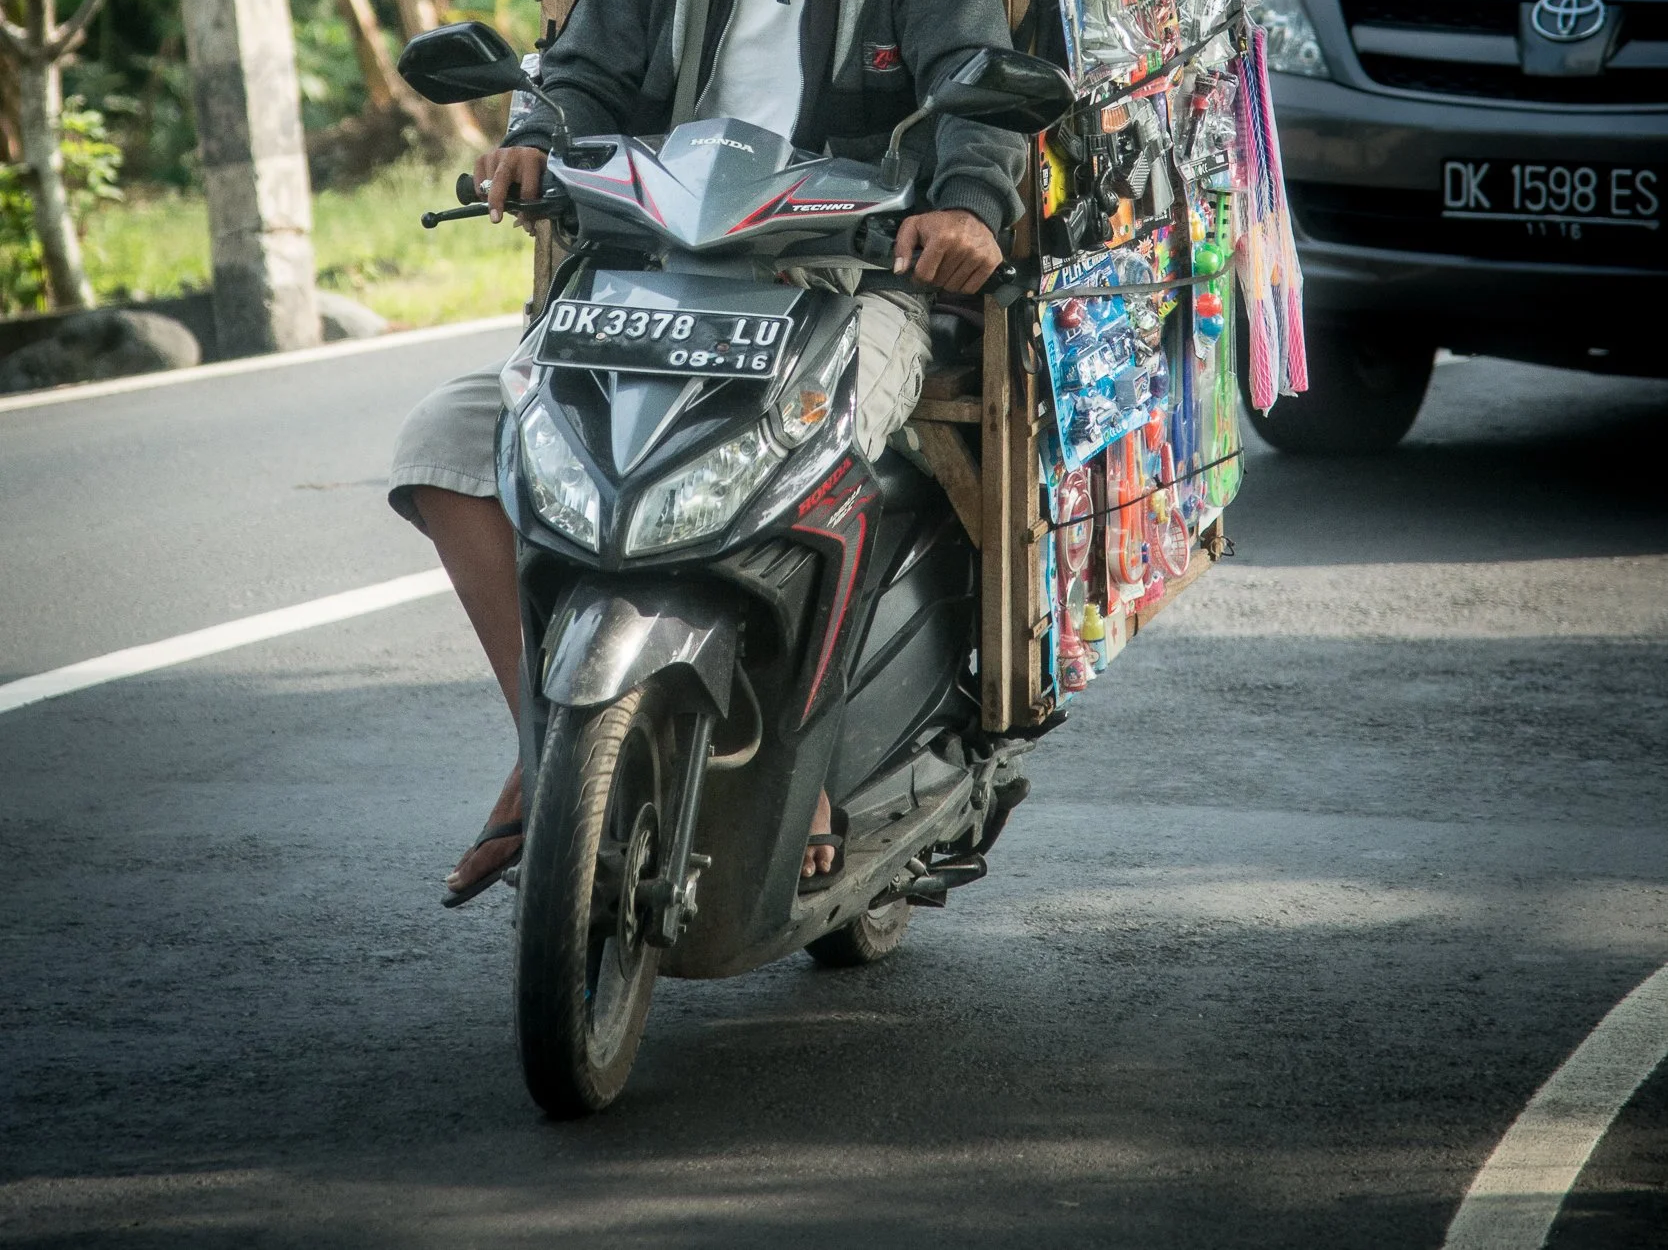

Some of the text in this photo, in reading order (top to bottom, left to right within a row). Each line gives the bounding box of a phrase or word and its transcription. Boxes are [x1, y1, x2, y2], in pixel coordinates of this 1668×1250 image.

[690, 138, 754, 153] HONDA
[1444, 161, 1659, 216] DK 1598 ES
[792, 203, 855, 212] TECHNO
[551, 305, 780, 346] DK 3378 LU
